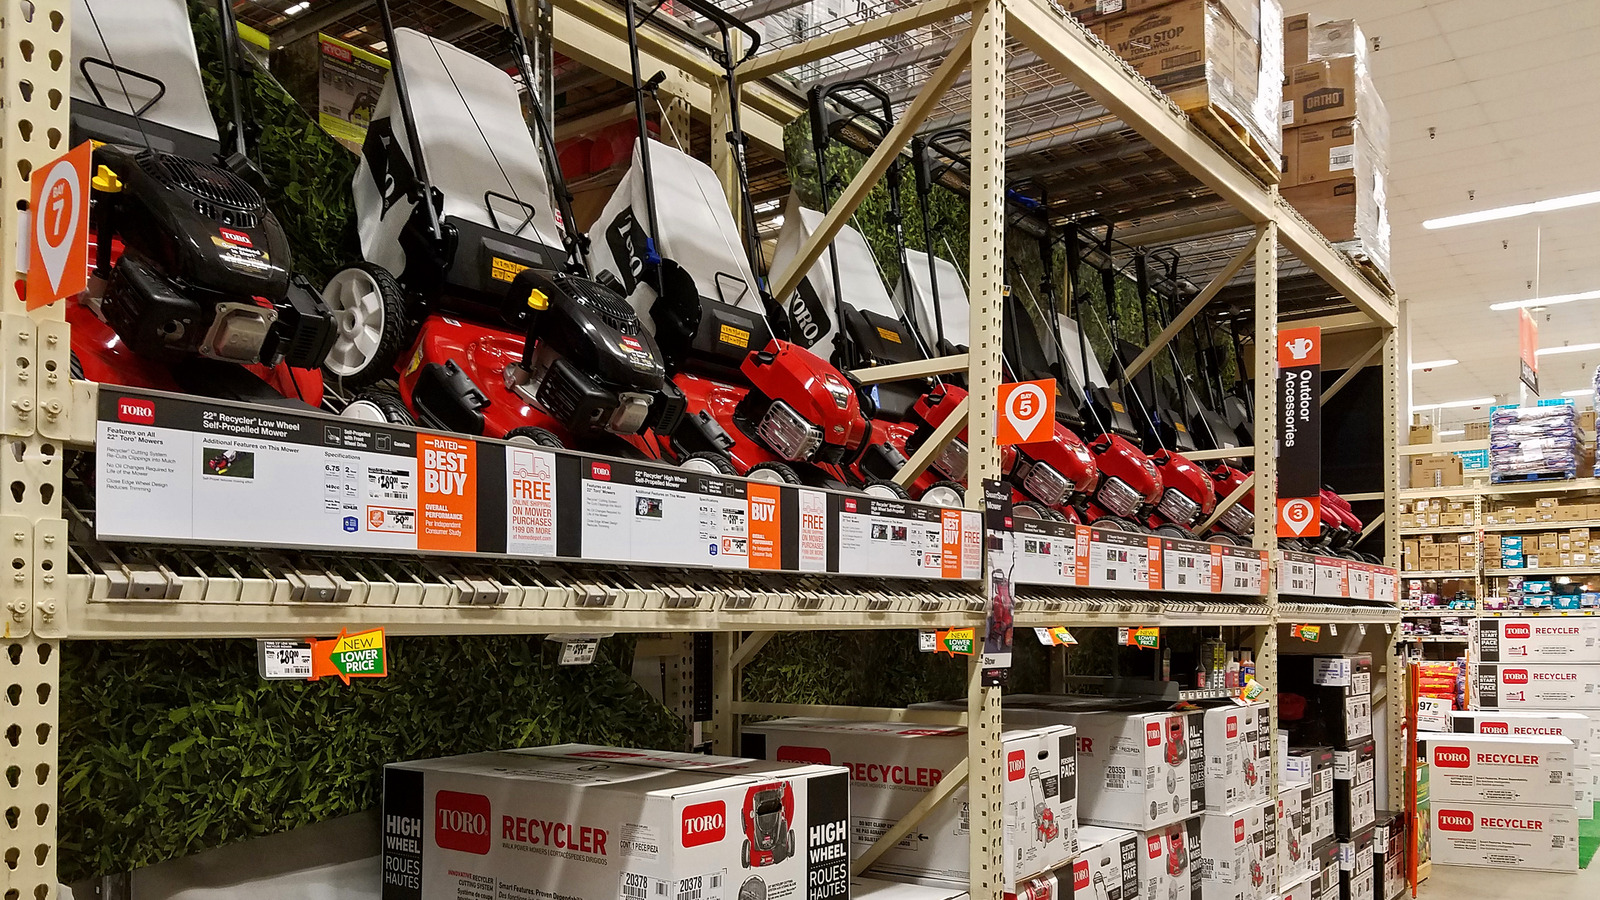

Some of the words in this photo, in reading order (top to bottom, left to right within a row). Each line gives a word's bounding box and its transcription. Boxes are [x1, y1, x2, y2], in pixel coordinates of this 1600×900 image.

[1118, 35, 1151, 53] WEED
[1153, 26, 1184, 43] STOP
[1307, 93, 1340, 108] ORTHO
[53, 183, 65, 198] BAY
[53, 199, 65, 236] 7
[222, 232, 252, 245] TORO
[1300, 370, 1313, 422] Outdoor
[121, 404, 152, 417] TORO
[1019, 400, 1032, 416] 5
[1285, 371, 1298, 448] Accessories
[203, 420, 260, 435] Self-Propelled
[261, 426, 288, 438] Mower
[219, 412, 255, 425] Recycler
[258, 418, 275, 428] Low
[276, 419, 300, 431] Wheel
[107, 427, 135, 436] Features
[138, 437, 163, 446] Mowers
[203, 437, 232, 447] Additional
[233, 441, 258, 450] Features
[280, 446, 299, 454] Mower
[434, 440, 457, 450] RATED
[325, 452, 361, 461] Specifications
[425, 449, 467, 472] BEST
[593, 467, 610, 476] TORO
[425, 469, 467, 496] BUY
[513, 479, 551, 500] FREE
[425, 503, 448, 511] OVERALL
[513, 506, 522, 515] ON
[525, 507, 552, 517] MOWER
[752, 503, 775, 522] BUY
[1293, 509, 1303, 519] 3
[425, 511, 463, 521] PERFORMANCE
[513, 516, 552, 527] PURCHASES
[803, 514, 824, 530] FREE
[526, 526, 534, 534] OR
[535, 527, 551, 535] MORE
[944, 518, 959, 531] BEST
[944, 530, 959, 545] BUY
[964, 531, 980, 545] FREE
[1507, 627, 1528, 636] TORO
[343, 638, 373, 651] NEW
[949, 639, 970, 647] LOWER
[1522, 645, 1528, 656] 1
[340, 649, 378, 663] LOWER
[346, 660, 374, 674] PRICE
[1505, 673, 1527, 681] TORO
[1520, 691, 1526, 702] 1
[1482, 726, 1507, 734] TORO
[1514, 727, 1562, 736] RECYCLER
[1009, 758, 1025, 773] TORO
[1437, 752, 1468, 763] TORO
[1477, 753, 1539, 765] RECYCLER
[843, 762, 942, 788] RECYCLER
[1061, 763, 1075, 780] PACE
[1108, 765, 1125, 774] 20353
[386, 814, 420, 838] HIGH
[440, 809, 486, 835] TORO
[685, 813, 722, 835] TORO
[1441, 815, 1472, 826] TORO
[1481, 817, 1542, 830] RECYCLER
[502, 815, 607, 856] RECYCLER
[809, 820, 847, 847] HIGH
[386, 835, 420, 854] WHEEL
[514, 844, 528, 852] POWER
[810, 842, 847, 864] WHEEL
[1123, 850, 1136, 863] START
[386, 856, 420, 876] ROUES
[386, 872, 419, 890] HAUTES
[472, 874, 494, 885] RECYCLER
[626, 872, 648, 889] 20378
[810, 863, 847, 887] ROUES
[1074, 868, 1088, 884] TORO
[1123, 867, 1137, 881] PACE
[459, 879, 477, 890] CUTTING
[477, 883, 494, 892] SYSTEM
[499, 882, 513, 892] Smart
[536, 889, 552, 900] Proven
[680, 875, 702, 892] 20378
[810, 880, 847, 900] HAUTES
